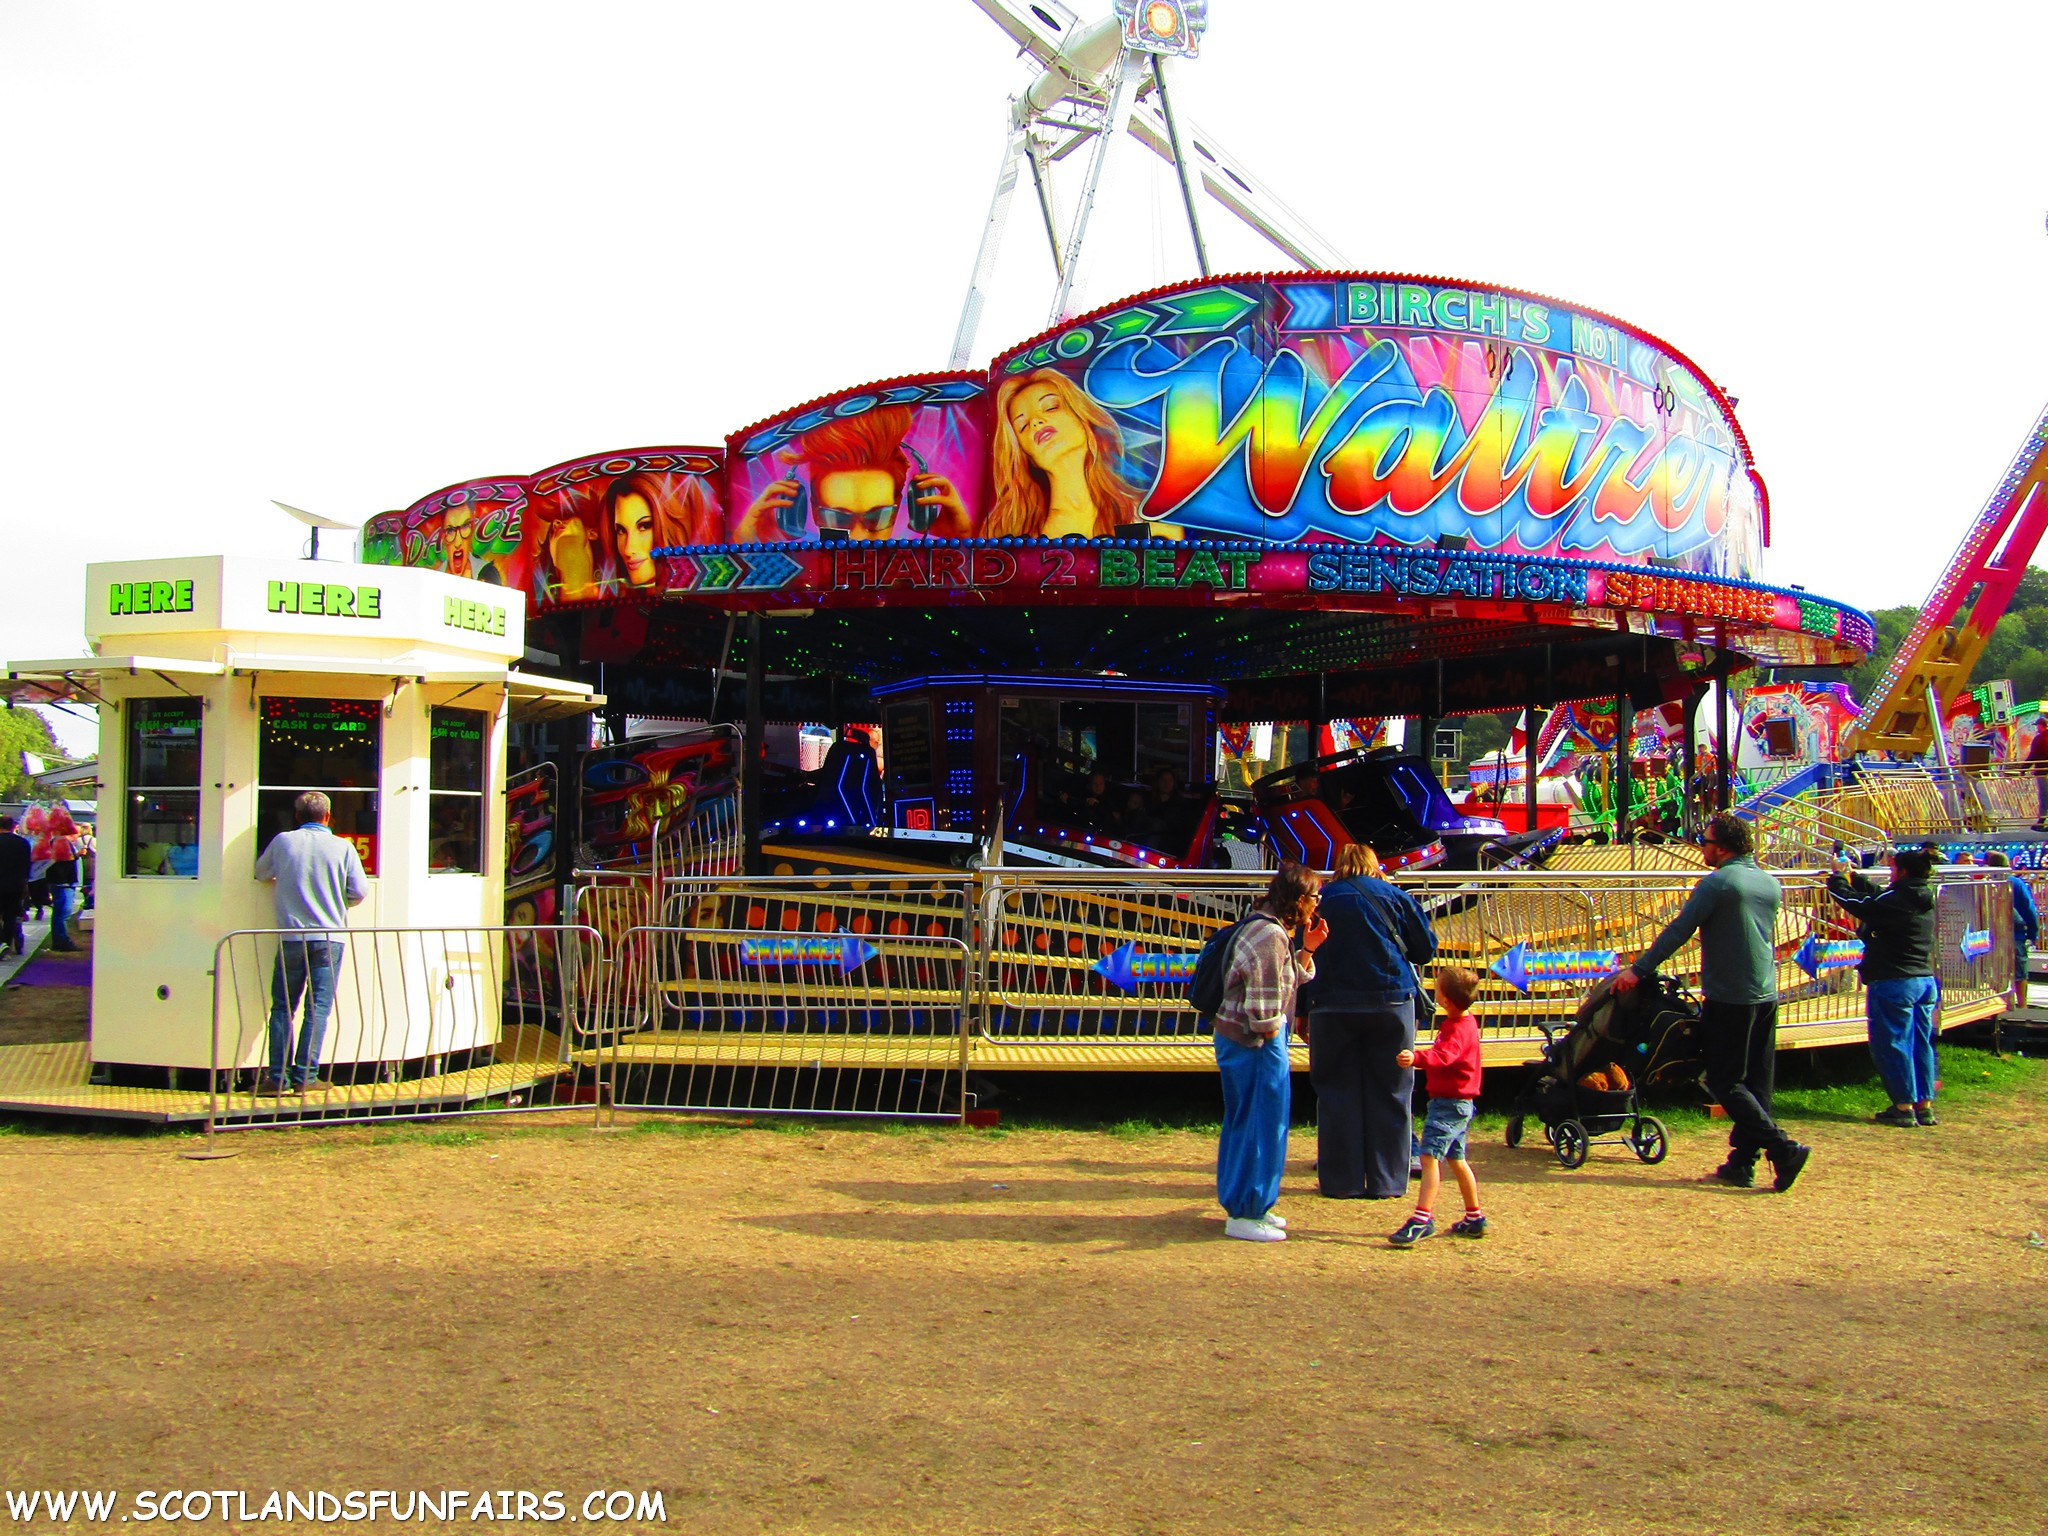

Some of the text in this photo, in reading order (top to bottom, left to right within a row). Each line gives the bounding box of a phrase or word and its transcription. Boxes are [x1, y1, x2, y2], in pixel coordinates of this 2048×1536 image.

[1348, 282, 1551, 344] BIRCH'S
[1084, 335, 1732, 539] Waltzer
[405, 498, 528, 566] DACE
[110, 579, 194, 615] HERE
[267, 580, 382, 619] HERE
[833, 548, 1017, 591] HARD
[1041, 548, 1078, 588] 2
[1099, 549, 1262, 590] BEAT
[1307, 552, 1589, 603] SENSATION
[1605, 570, 1776, 624] SPINNING
[443, 595, 506, 636] HERE
[272, 719, 367, 732] CASH or CARD
[298, 711, 340, 719] WE ACCEPT
[432, 726, 447, 737] ASH
[460, 729, 481, 740] CARD
[345, 836, 370, 860] 5
[747, 939, 842, 961] ENTRANCE
[1523, 954, 1612, 976] ENTRANCE
[1130, 956, 1197, 978] ENTRA
